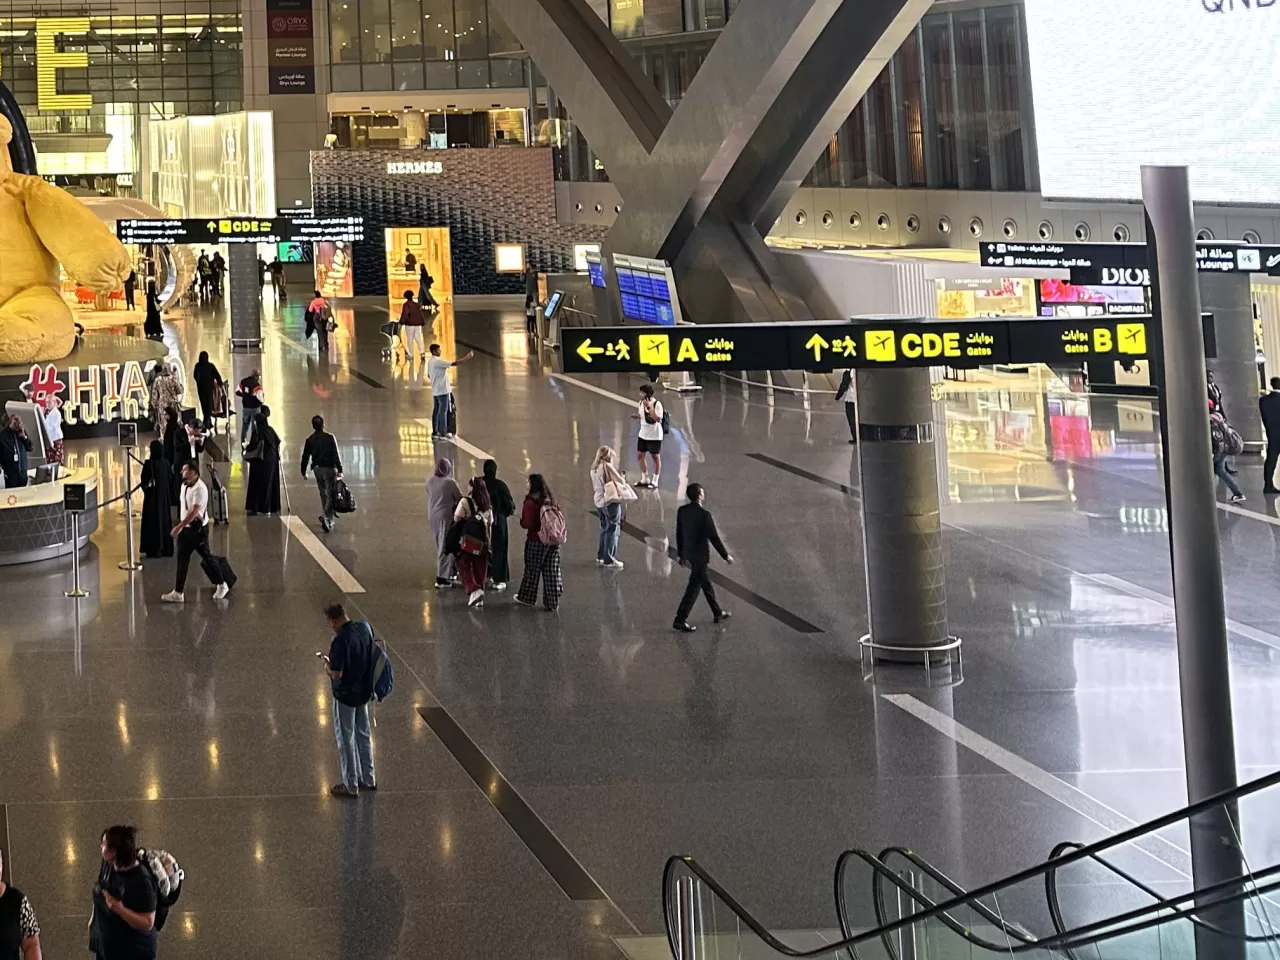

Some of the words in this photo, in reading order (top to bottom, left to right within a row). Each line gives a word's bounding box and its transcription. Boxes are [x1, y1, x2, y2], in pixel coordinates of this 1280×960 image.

[233, 221, 259, 233] CDE
[1195, 248, 1208, 258] الم
[1209, 248, 1234, 259] صالة
[1200, 260, 1234, 271] Lounge
[966, 331, 994, 345] بوابات
[1061, 329, 1089, 342] بوابات
[1093, 328, 1113, 353] B
[676, 337, 699, 363] A
[704, 338, 734, 351] بوابات
[900, 331, 962, 359] CDE
[966, 345, 992, 356] Gates
[1064, 343, 1089, 354] Gates
[705, 351, 732, 362] Gates
